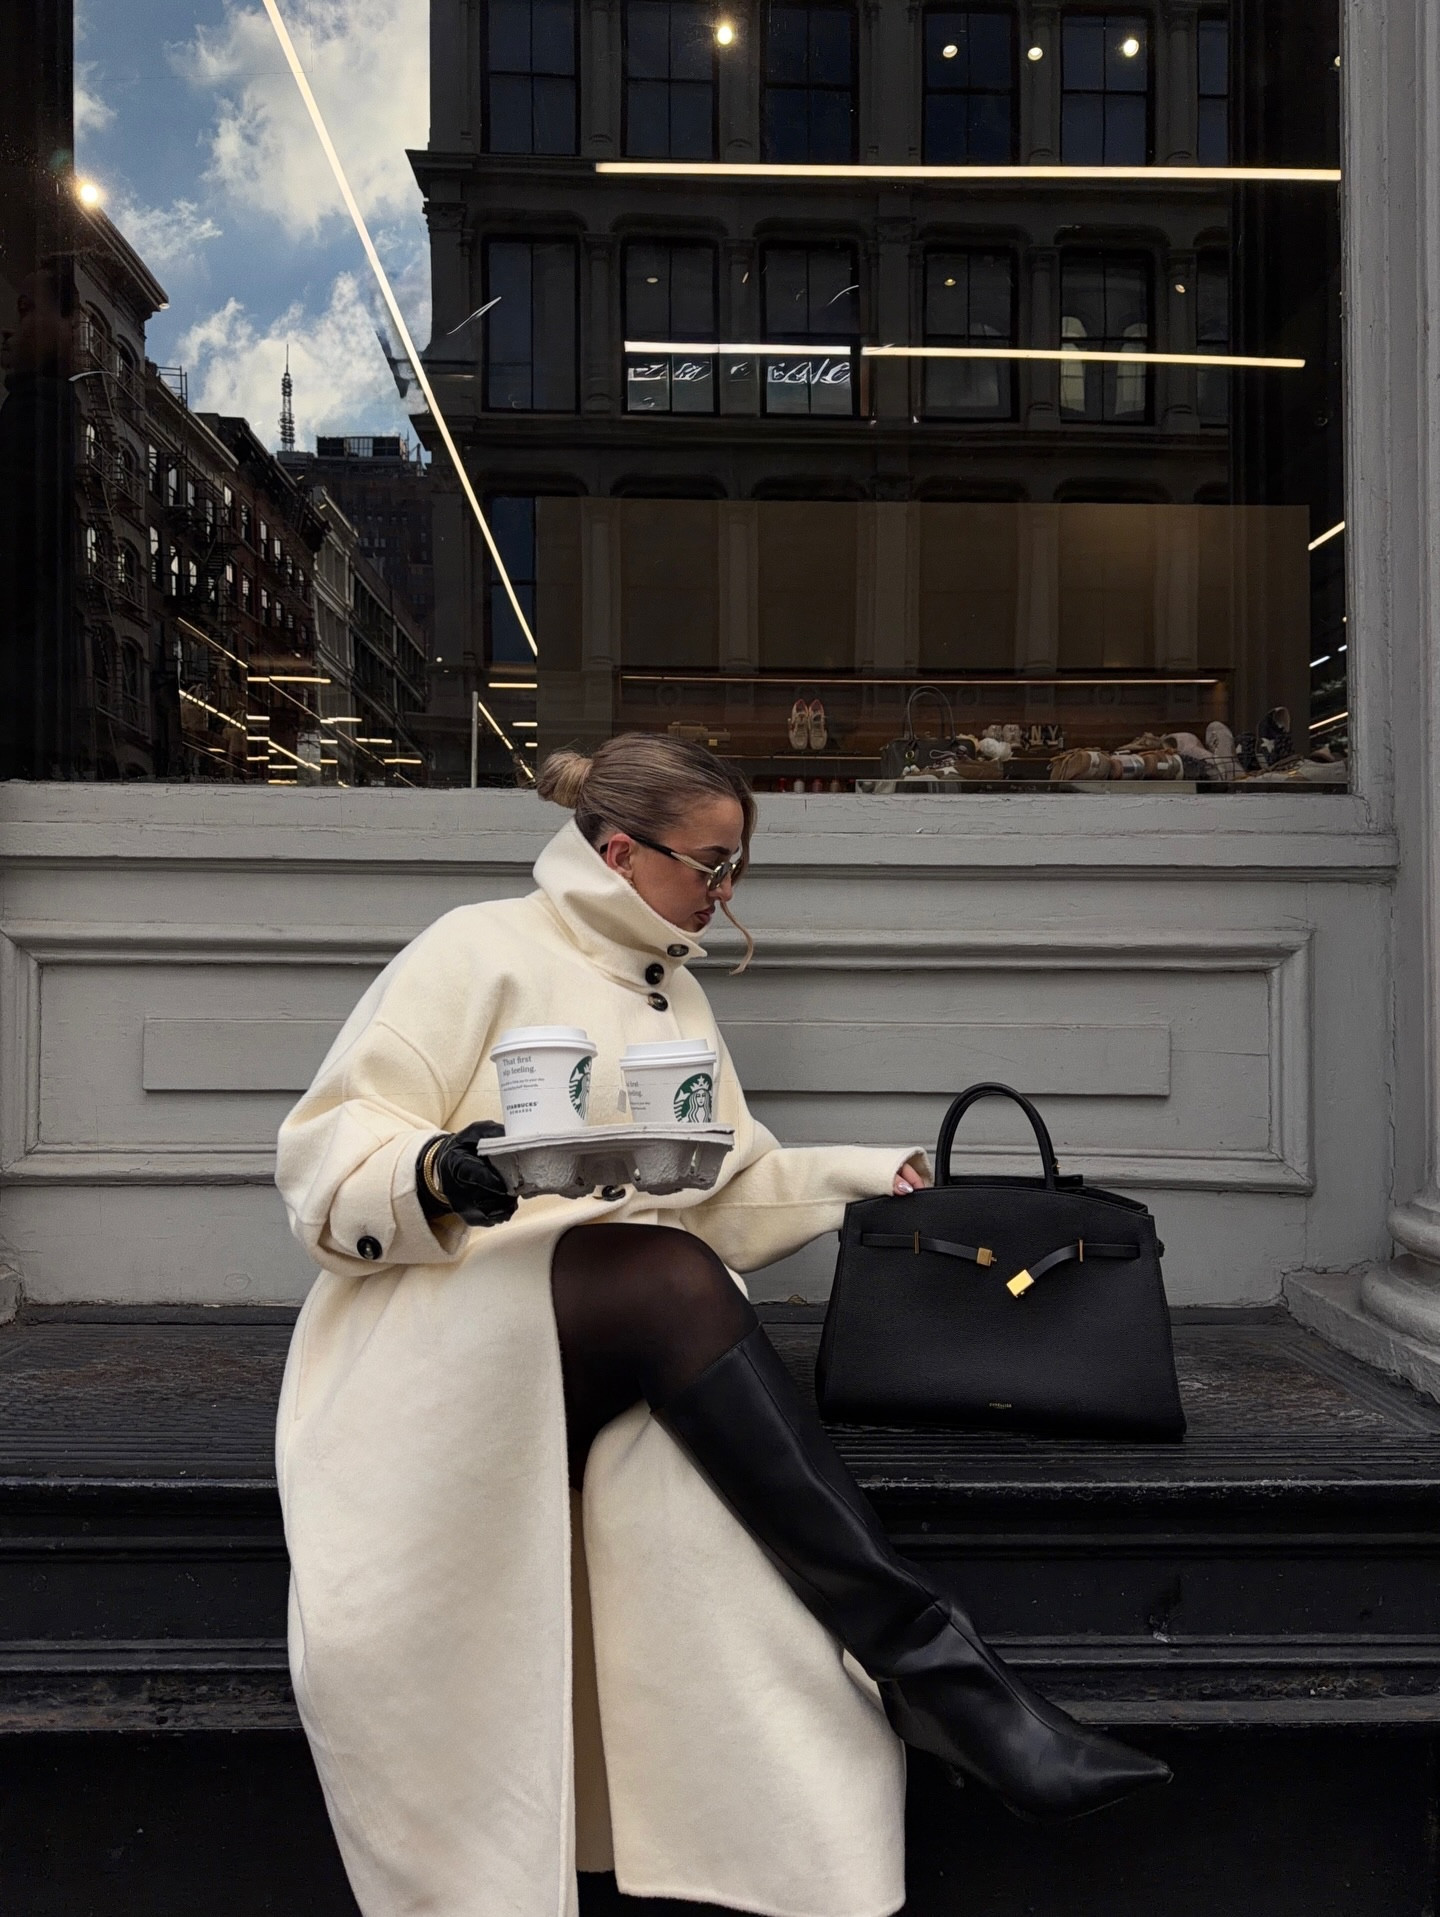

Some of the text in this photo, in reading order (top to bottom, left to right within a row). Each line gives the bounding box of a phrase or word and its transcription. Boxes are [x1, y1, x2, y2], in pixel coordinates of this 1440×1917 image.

[502, 1055, 532, 1066] That first
[511, 1065, 536, 1075] feeling.
